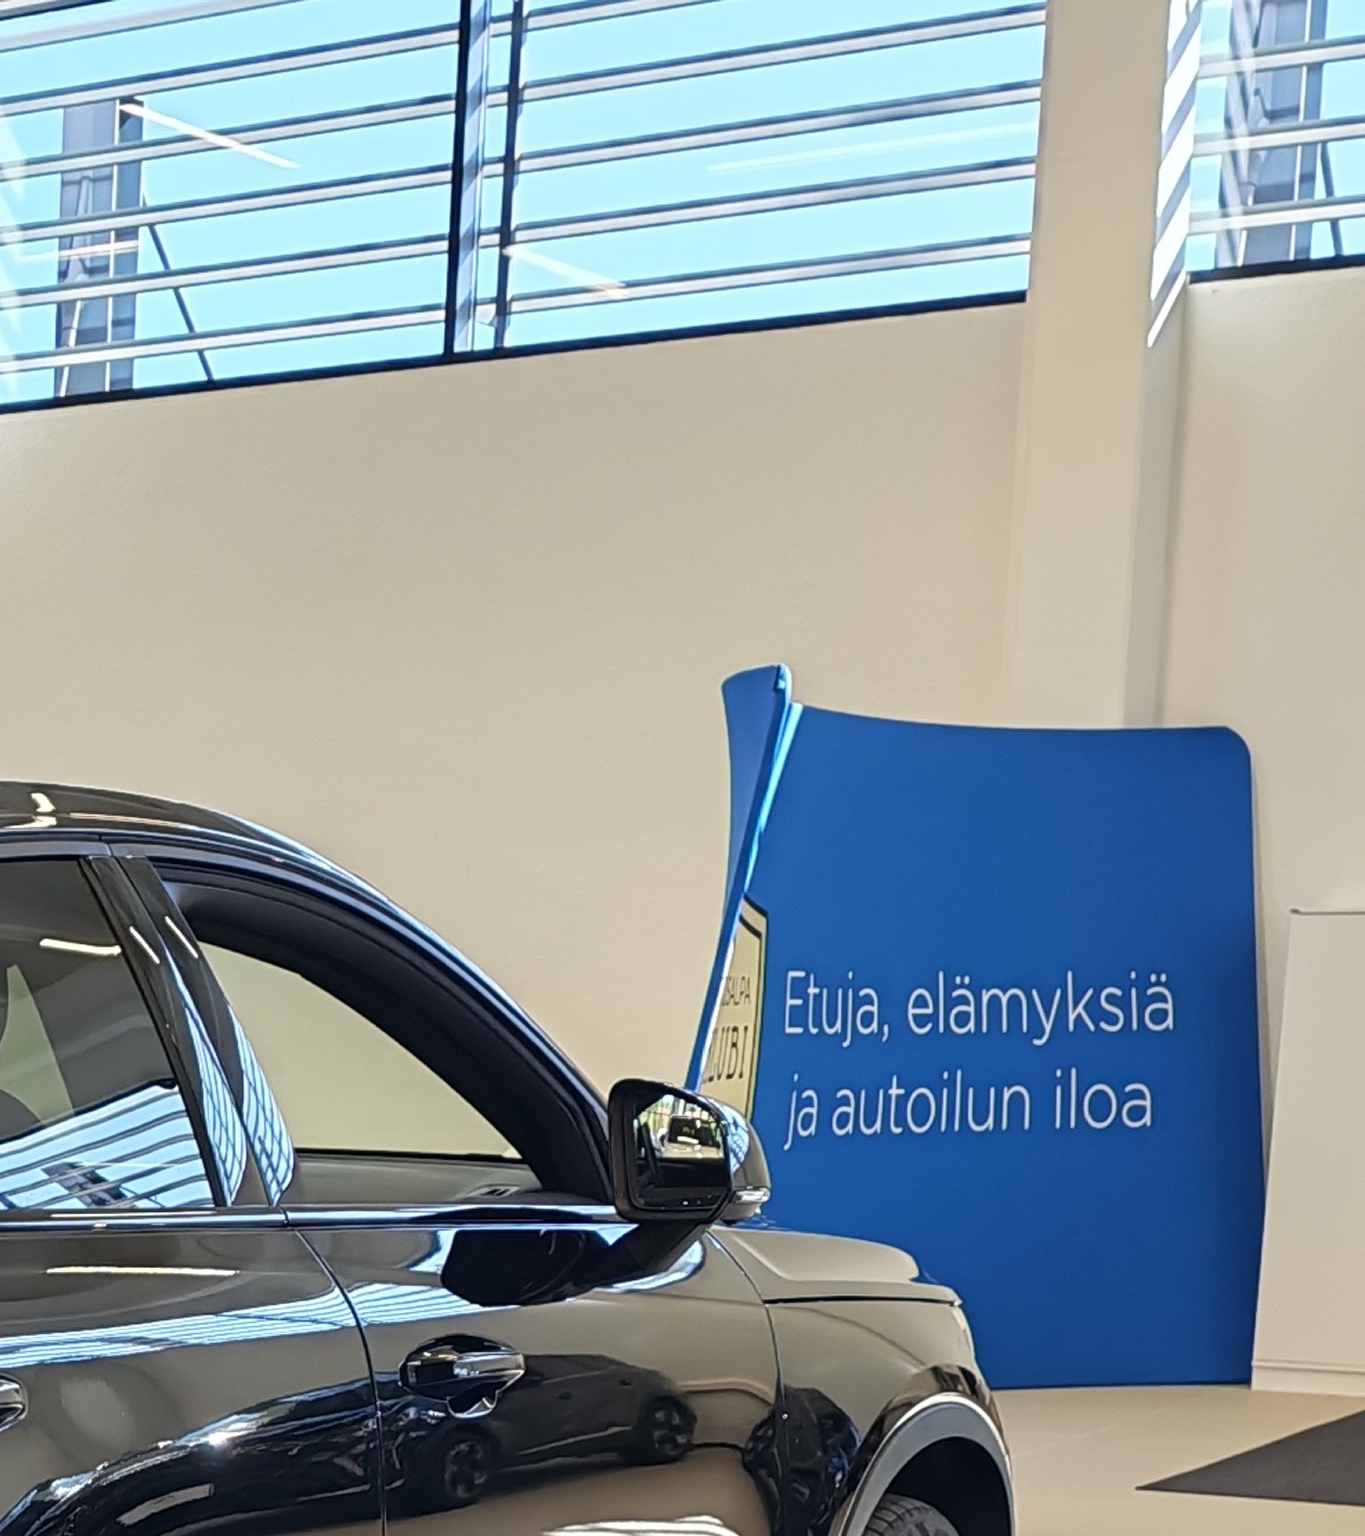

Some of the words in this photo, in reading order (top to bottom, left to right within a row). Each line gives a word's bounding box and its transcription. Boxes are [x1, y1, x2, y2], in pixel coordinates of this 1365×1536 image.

[784, 969, 890, 1047] Etuja,
[906, 970, 1175, 1047] elämyksiä
[702, 1024, 749, 1084] LUBI
[782, 1073, 819, 1151] ja
[831, 1069, 1031, 1137] autoilun
[1054, 1067, 1152, 1131] iloa
